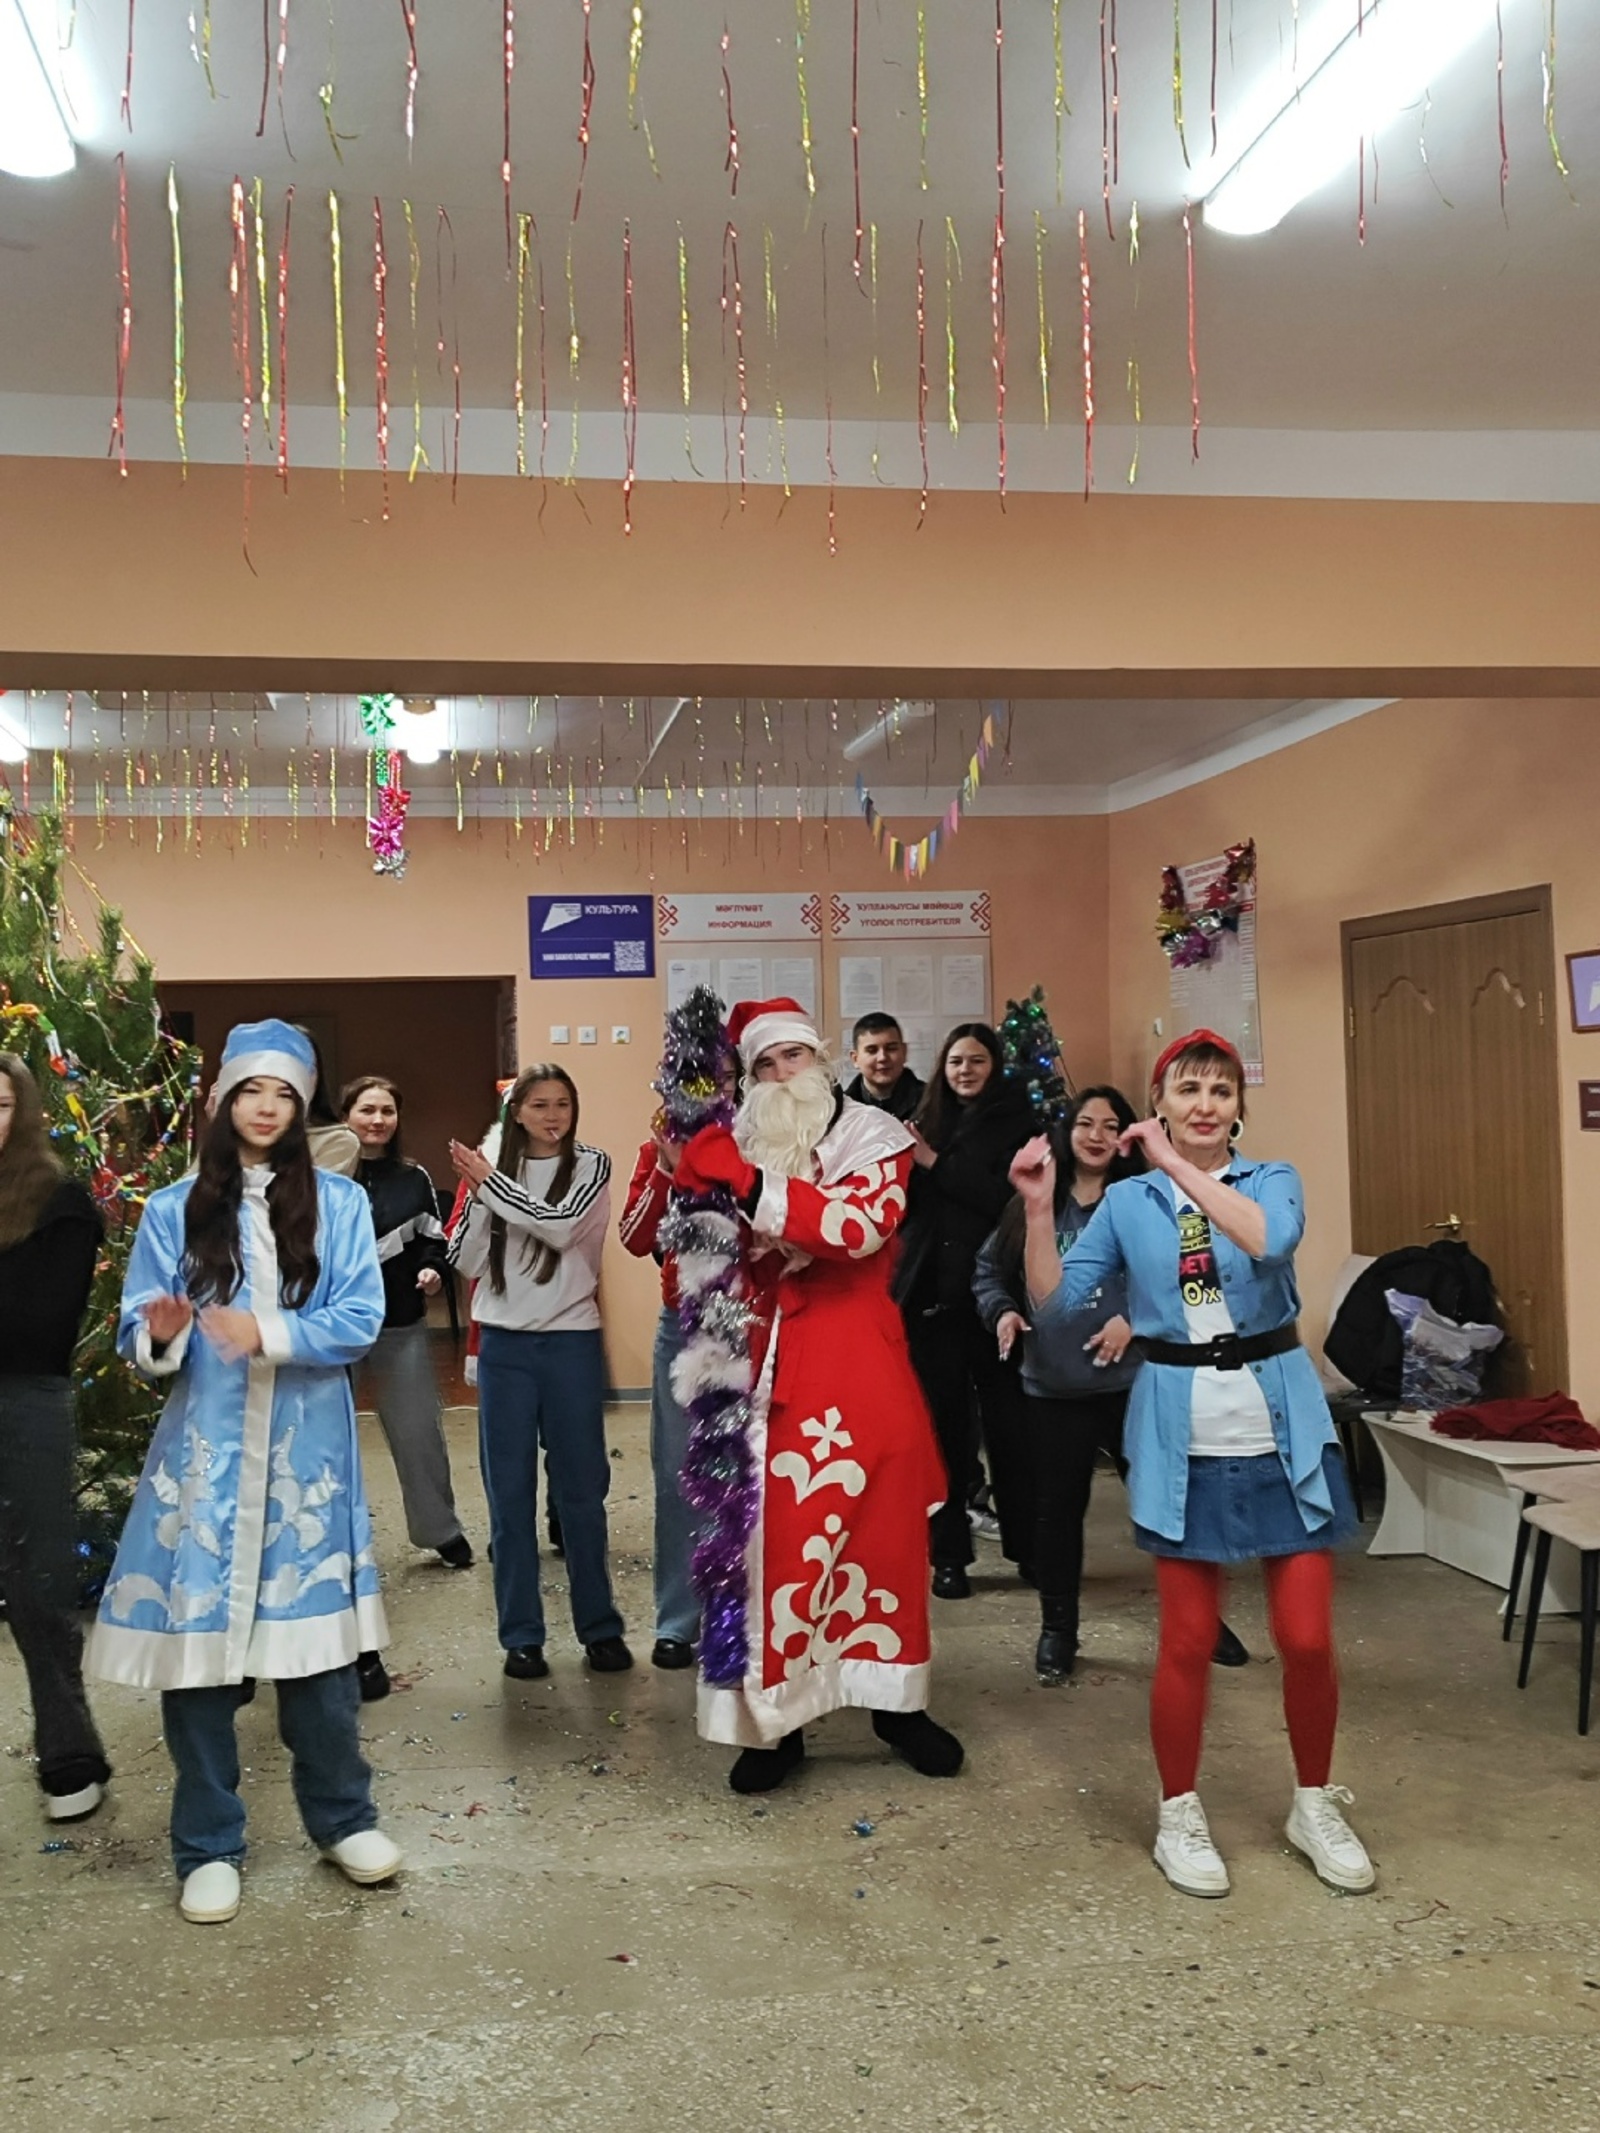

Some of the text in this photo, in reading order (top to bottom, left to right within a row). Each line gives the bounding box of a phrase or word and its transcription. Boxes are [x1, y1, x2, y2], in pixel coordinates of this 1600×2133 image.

[585, 904, 639, 915] КУЛЬТУРА
[708, 920, 773, 929] ИНФОРМАЦИЯ
[860, 917, 961, 927] УГОЛОК ПОТРЕБИТЕЛЯ
